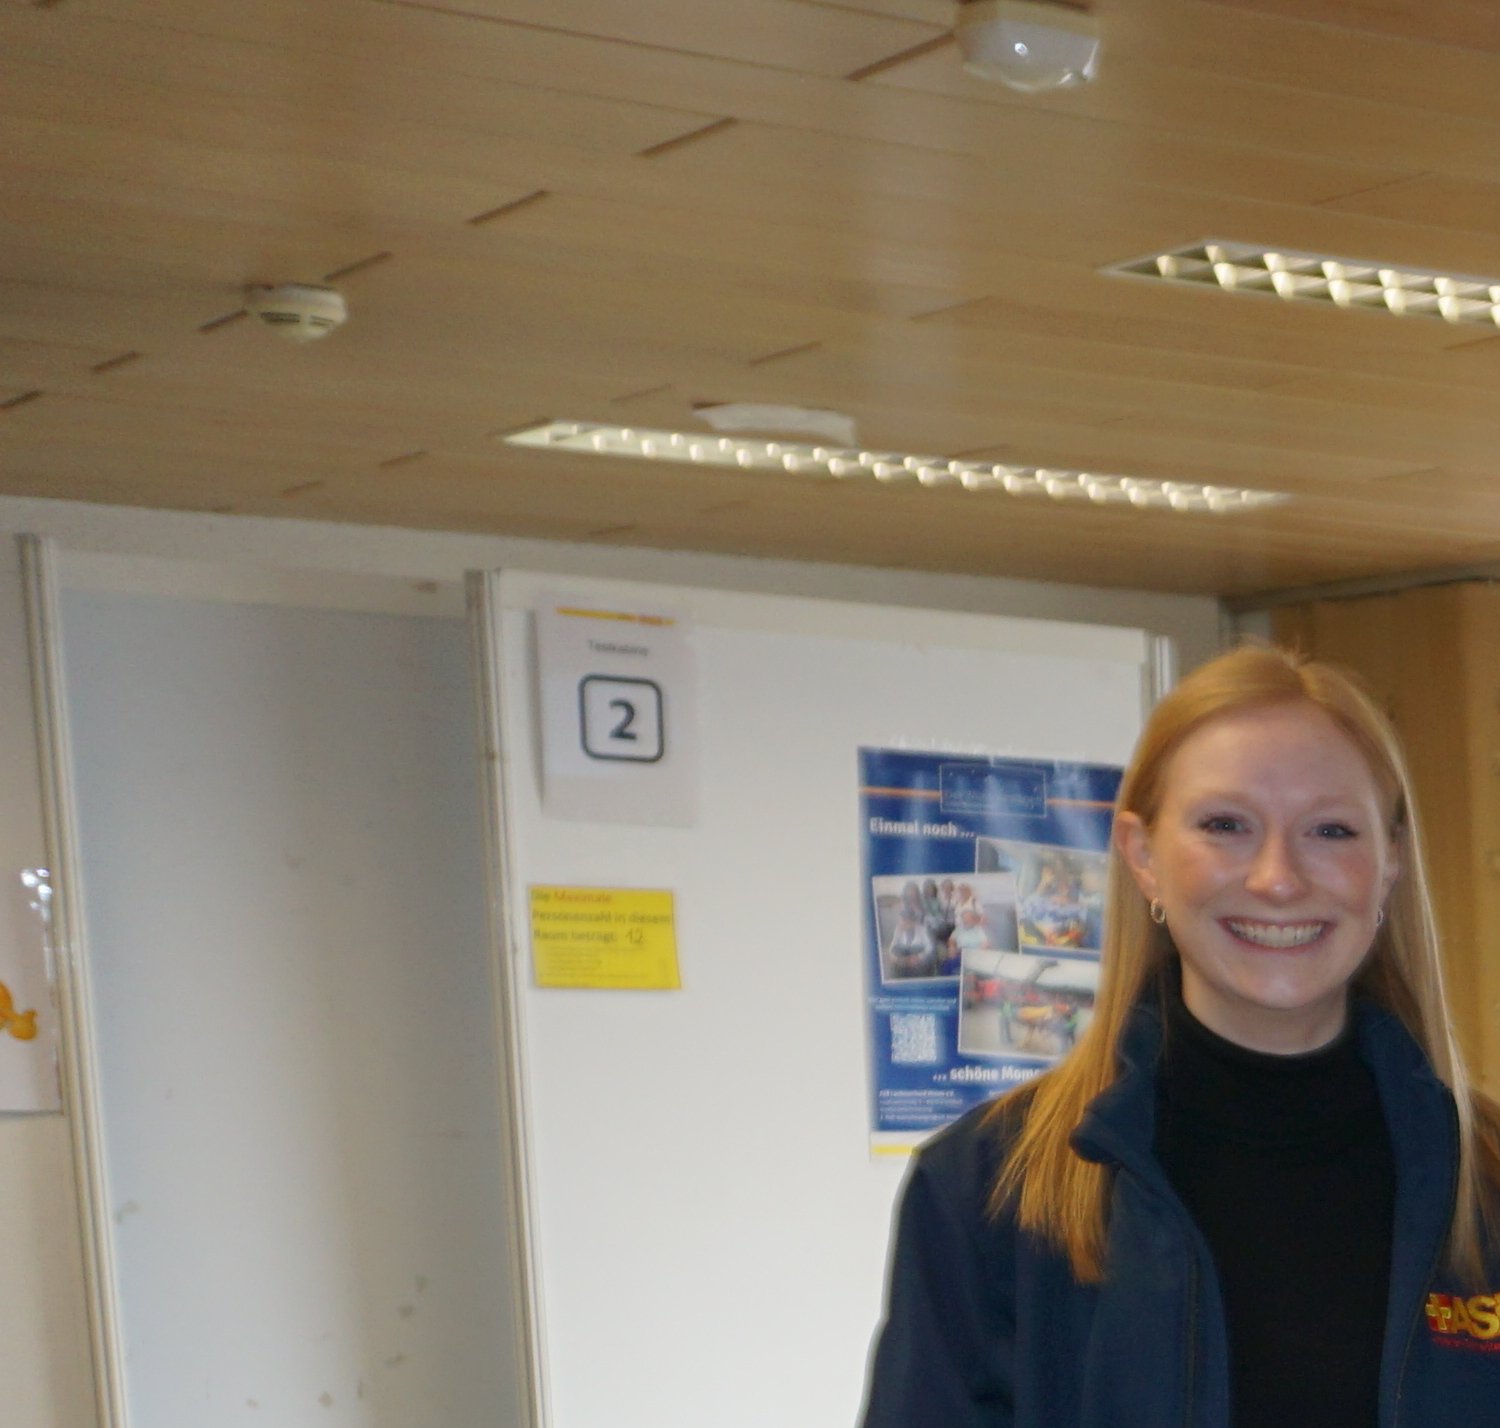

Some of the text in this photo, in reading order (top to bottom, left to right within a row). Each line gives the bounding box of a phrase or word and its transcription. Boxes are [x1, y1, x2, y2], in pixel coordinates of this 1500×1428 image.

[609, 698, 637, 740] 2
[870, 817, 918, 834] Einmal
[923, 821, 957, 838] noch
[949, 1065, 999, 1081] schöne
